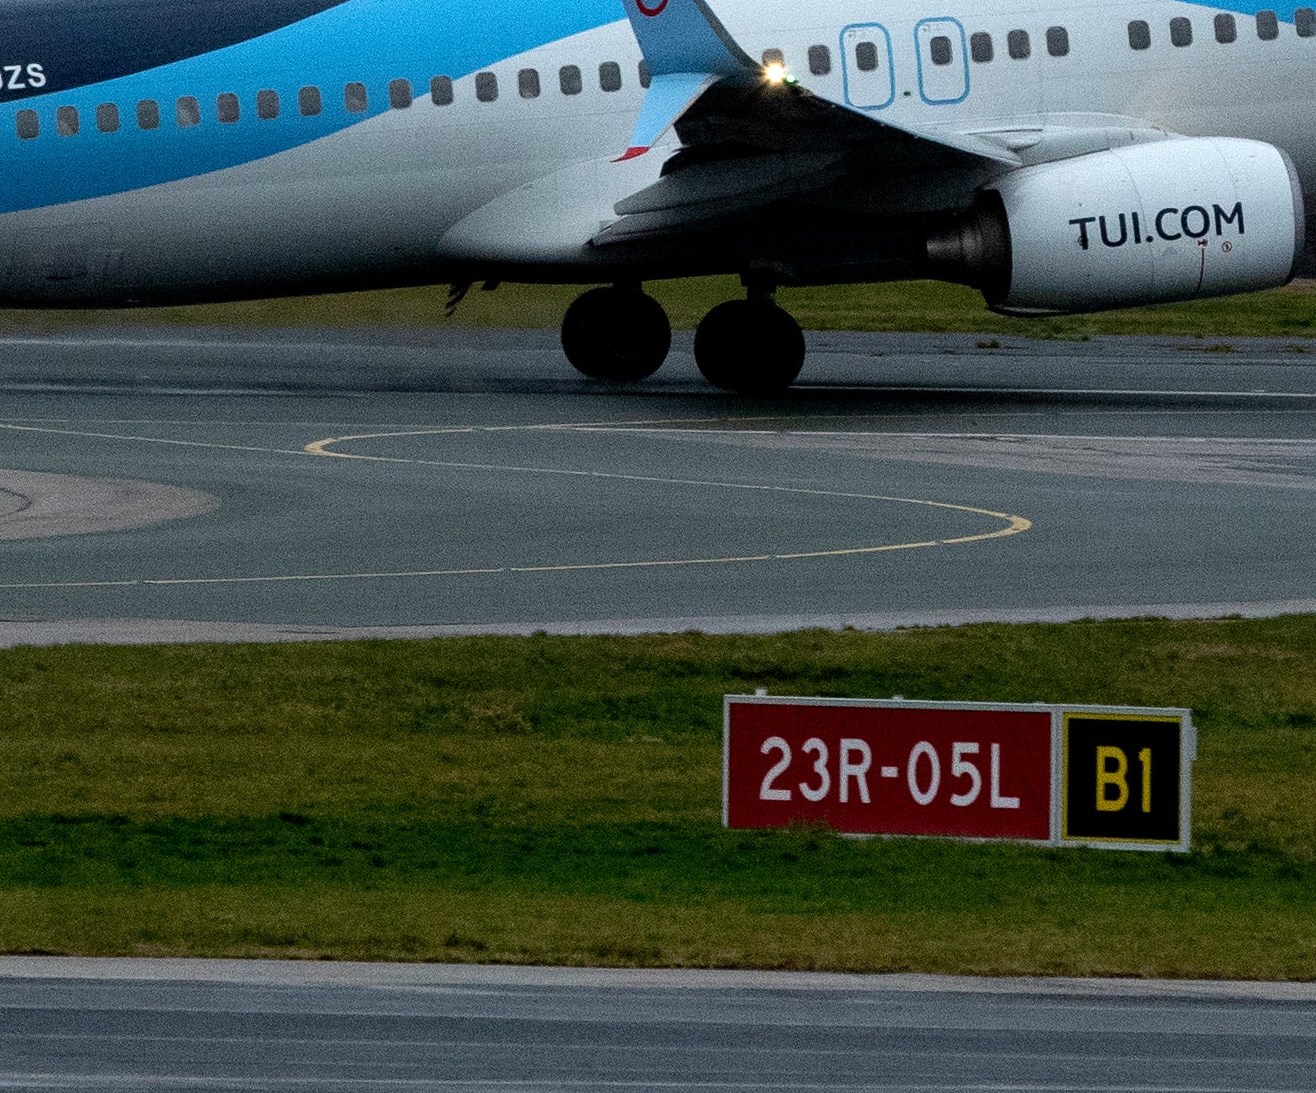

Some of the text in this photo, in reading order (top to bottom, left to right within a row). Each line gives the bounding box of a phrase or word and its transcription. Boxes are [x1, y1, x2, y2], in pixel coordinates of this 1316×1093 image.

[1068, 201, 1245, 251] TUI.COM
[759, 736, 1021, 809] 23R-05L
[1095, 745, 1153, 814] B1
